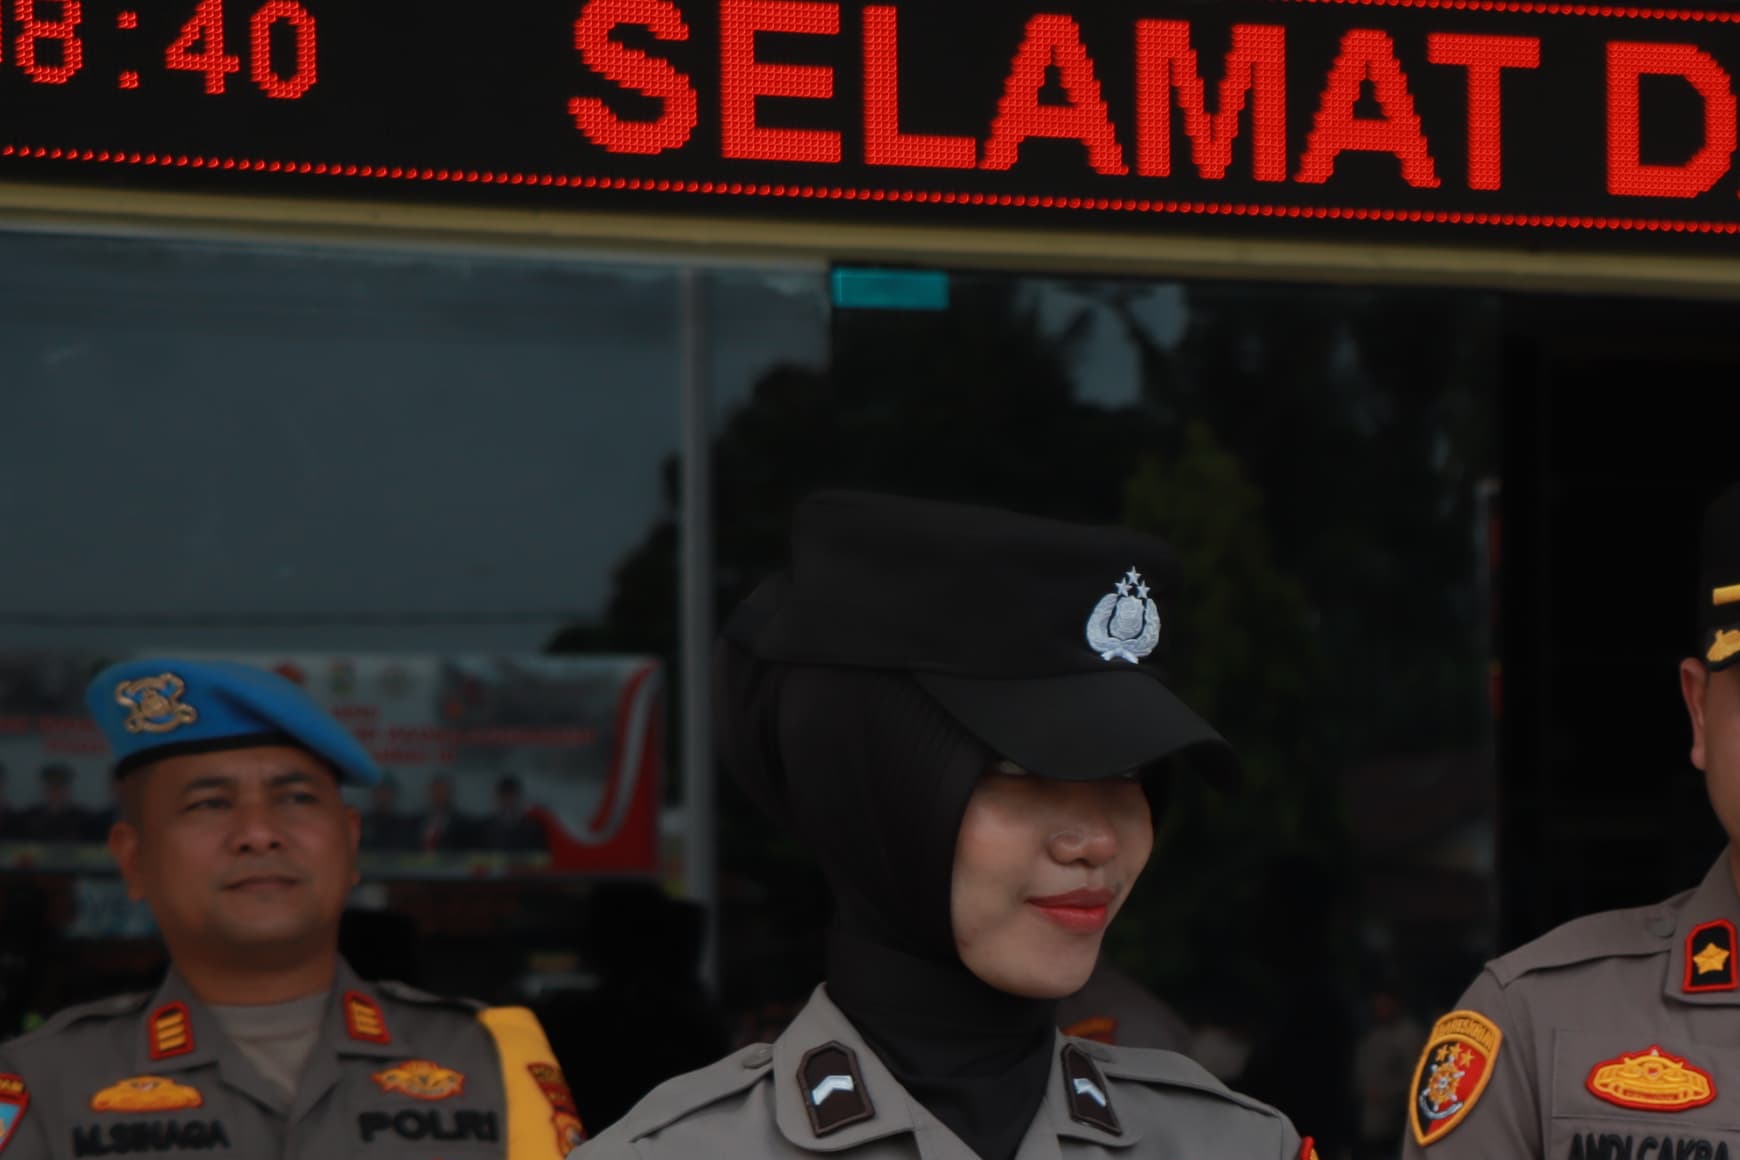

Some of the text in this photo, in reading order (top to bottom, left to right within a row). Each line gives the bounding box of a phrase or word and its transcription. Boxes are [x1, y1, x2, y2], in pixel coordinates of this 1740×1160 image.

[0, 0, 317, 99] 8:40
[569, 0, 1540, 190] SELAMAT
[358, 1109, 498, 1143] POLRI
